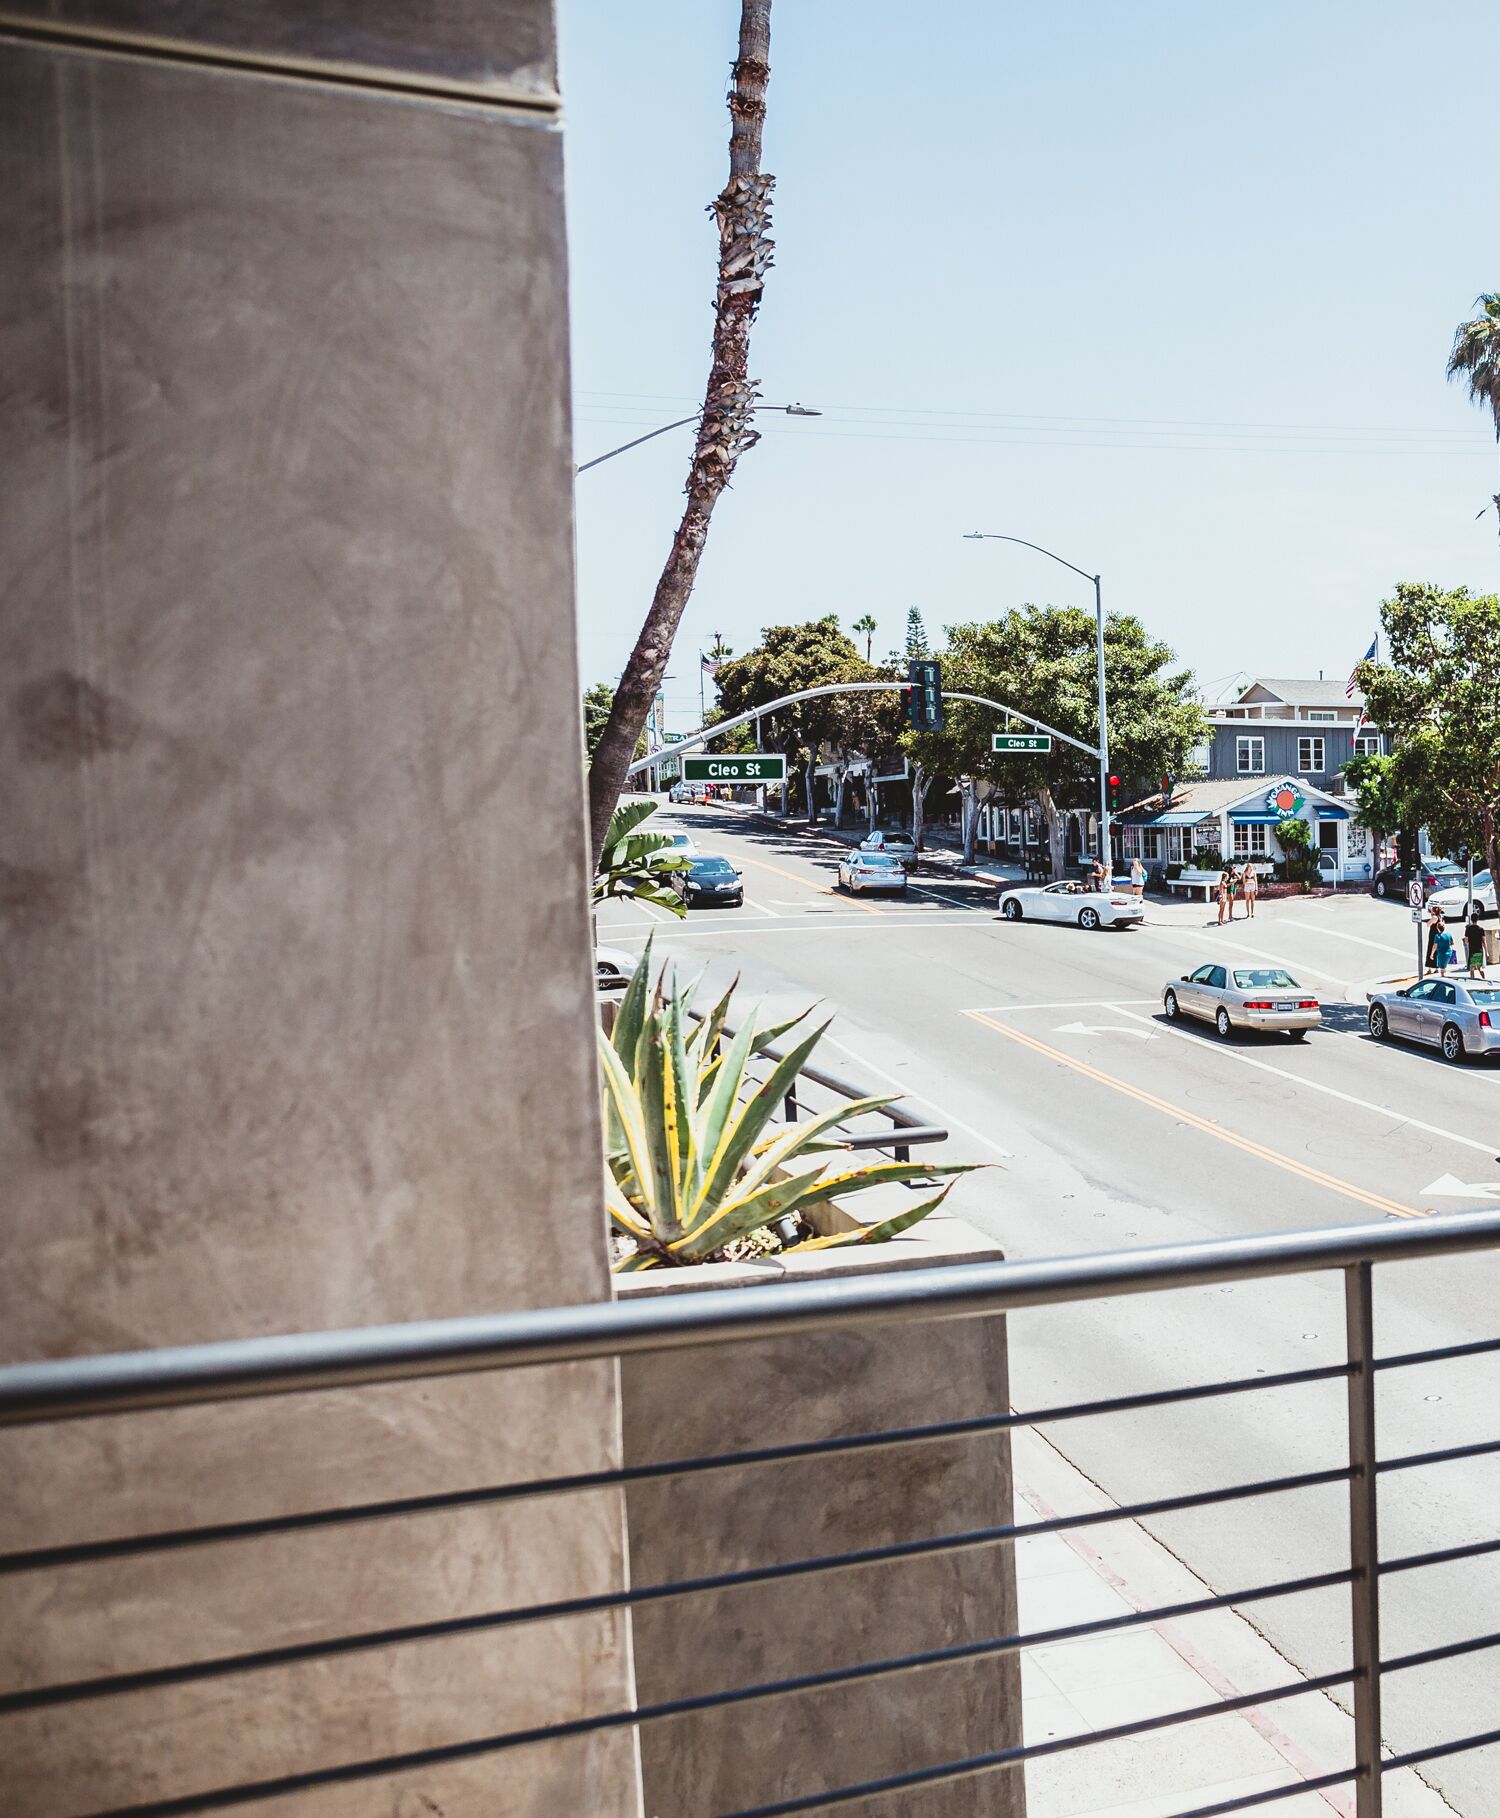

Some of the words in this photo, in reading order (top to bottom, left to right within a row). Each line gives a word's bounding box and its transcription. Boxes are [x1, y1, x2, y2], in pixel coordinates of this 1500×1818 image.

[1008, 739, 1025, 748] Cleo
[1028, 739, 1037, 748] St
[708, 763, 739, 776] Cleo
[745, 763, 761, 776] St
[1270, 783, 1301, 800] ORANGE
[1276, 808, 1295, 817] INN
